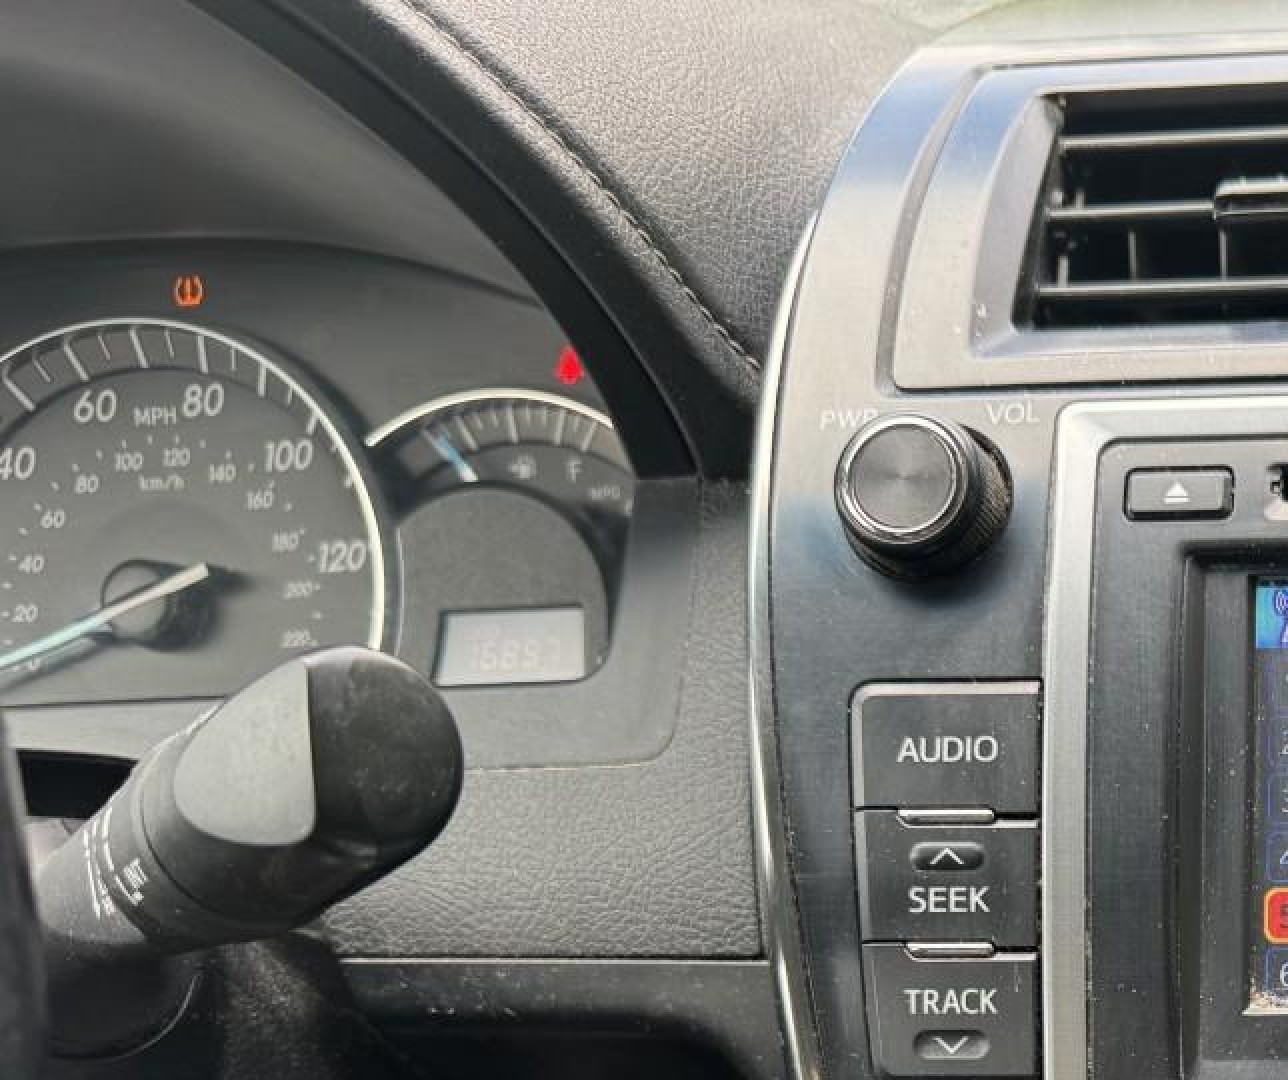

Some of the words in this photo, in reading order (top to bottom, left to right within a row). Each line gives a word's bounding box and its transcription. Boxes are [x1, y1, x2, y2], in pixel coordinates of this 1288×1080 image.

[73, 389, 117, 423] 60
[182, 383, 225, 418] 80
[134, 406, 177, 427] MPH
[985, 401, 1041, 425] VOL
[0, 446, 36, 481] 40
[114, 451, 143, 473] 100
[264, 439, 313, 473] 100
[138, 473, 185, 491] km/h
[208, 464, 237, 483] 140
[566, 456, 583, 484] F
[74, 474, 99, 495] 80
[247, 488, 274, 510] 160
[40, 508, 66, 529] 60
[18, 554, 45, 574] 40
[318, 539, 367, 574] 120
[12, 603, 38, 623] 20
[897, 735, 999, 763] AUDIO
[908, 885, 990, 914] SEEK
[903, 987, 998, 1016] TRACK
